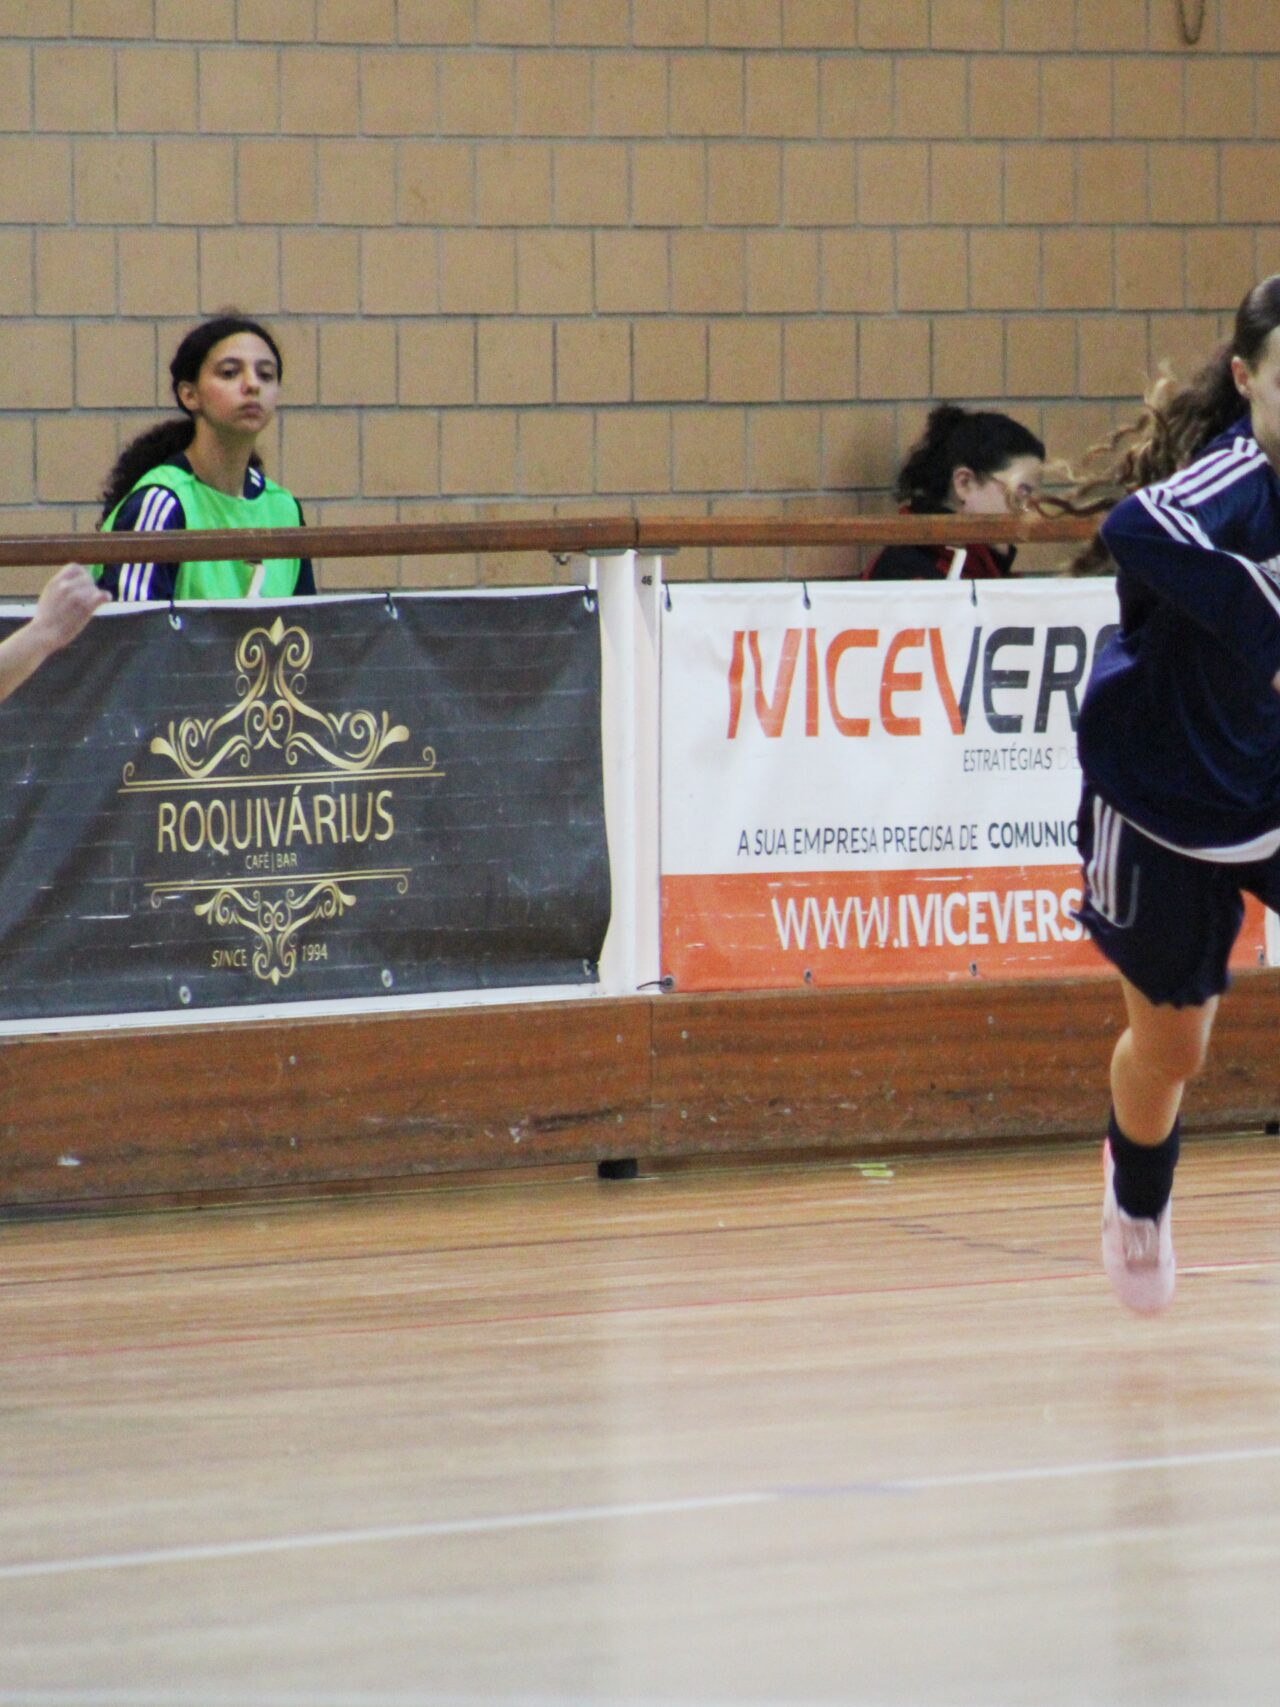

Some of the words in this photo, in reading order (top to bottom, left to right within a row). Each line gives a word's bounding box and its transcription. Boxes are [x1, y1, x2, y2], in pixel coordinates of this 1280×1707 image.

[727, 623, 1121, 739] IVICEVER
[963, 742, 1053, 772] ESTRATÉGIAS
[157, 786, 395, 854] ROQUIVÁRIUS
[737, 829, 750, 856] A
[754, 828, 788, 855] SUA
[793, 826, 879, 855] EMPRESA
[883, 824, 955, 853] PRECISA
[959, 823, 979, 851] DE
[245, 851, 269, 869] CAFÉ
[276, 852, 297, 868] BAR
[771, 888, 1092, 951] WWW.IVICEVERS
[211, 949, 247, 967] SINCE
[302, 944, 328, 961] 1994
